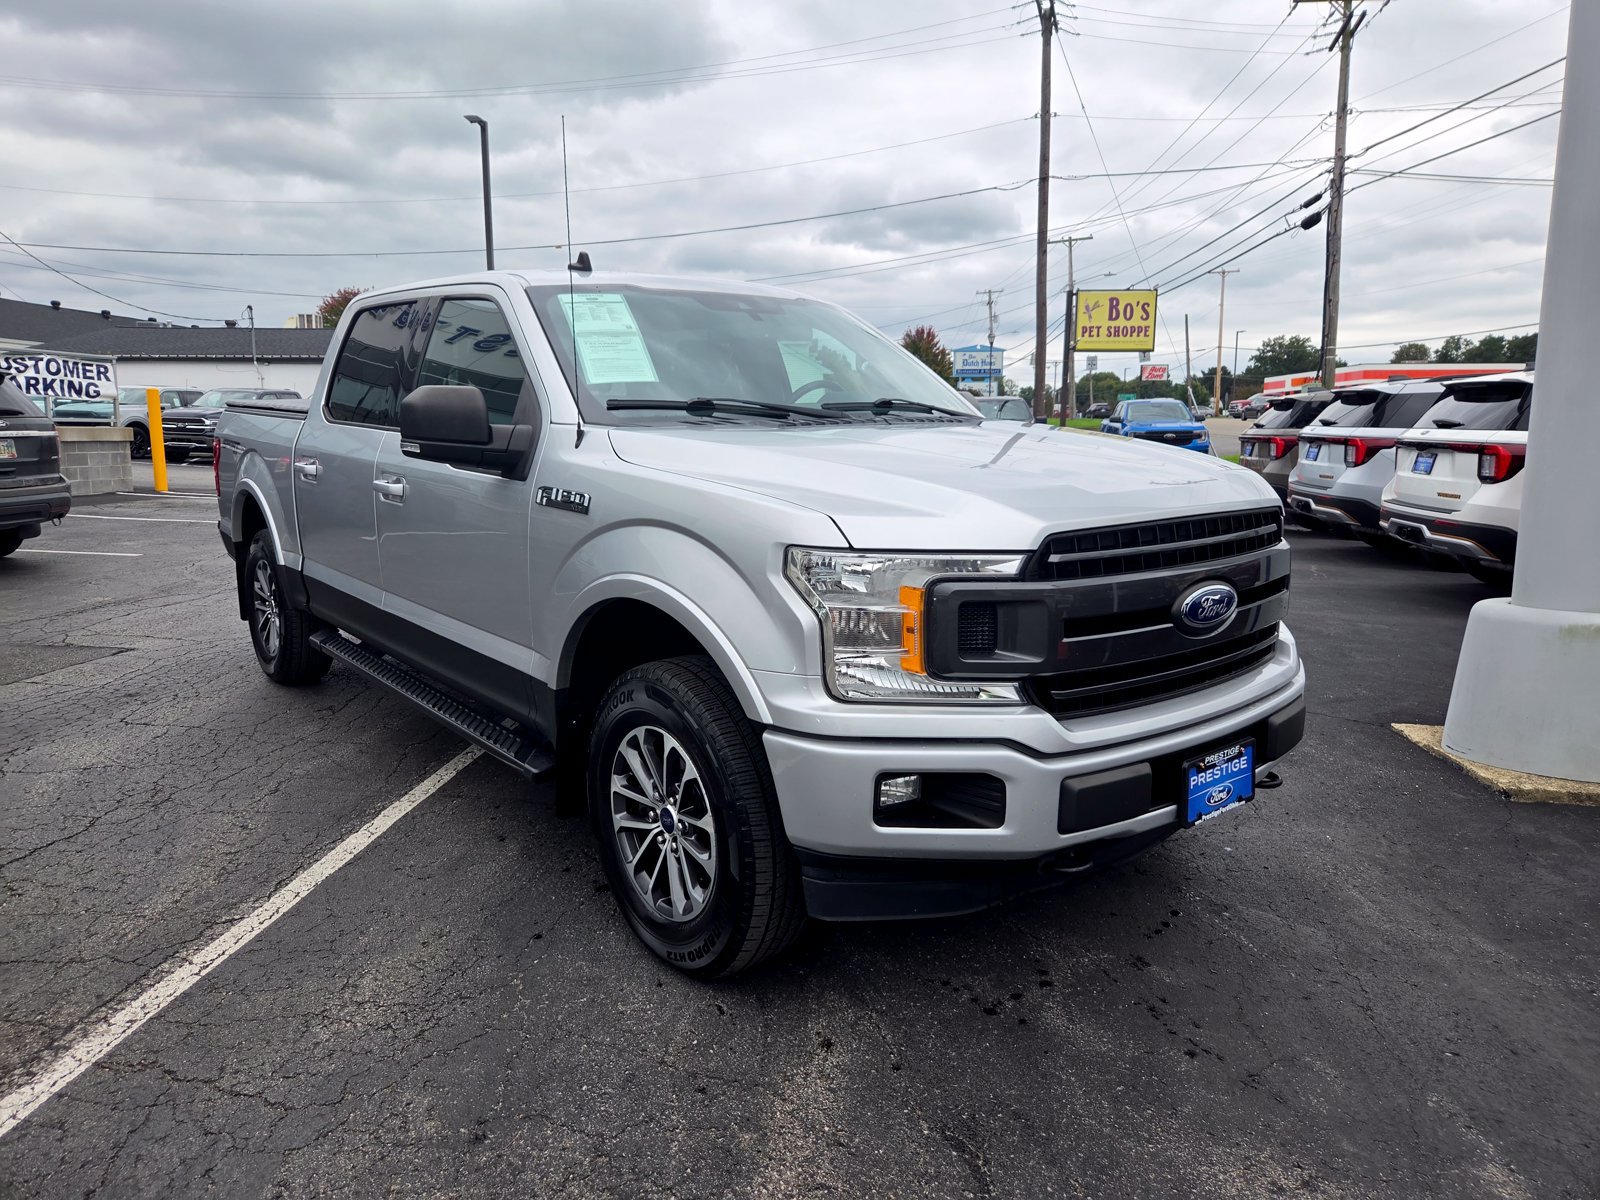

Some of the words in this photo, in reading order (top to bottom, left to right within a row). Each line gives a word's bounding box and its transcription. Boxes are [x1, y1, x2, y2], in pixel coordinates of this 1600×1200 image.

[1108, 297, 1150, 321] Bo's
[1081, 326, 1102, 337] PET
[1106, 326, 1150, 337] SHOPPE
[0, 356, 112, 382] USTOMER
[9, 375, 101, 399] ARKING
[1198, 595, 1228, 619] Ford
[1204, 745, 1240, 765] PRESTIGE
[1190, 756, 1248, 789] PRESTIGE
[1210, 786, 1228, 803] Ford
